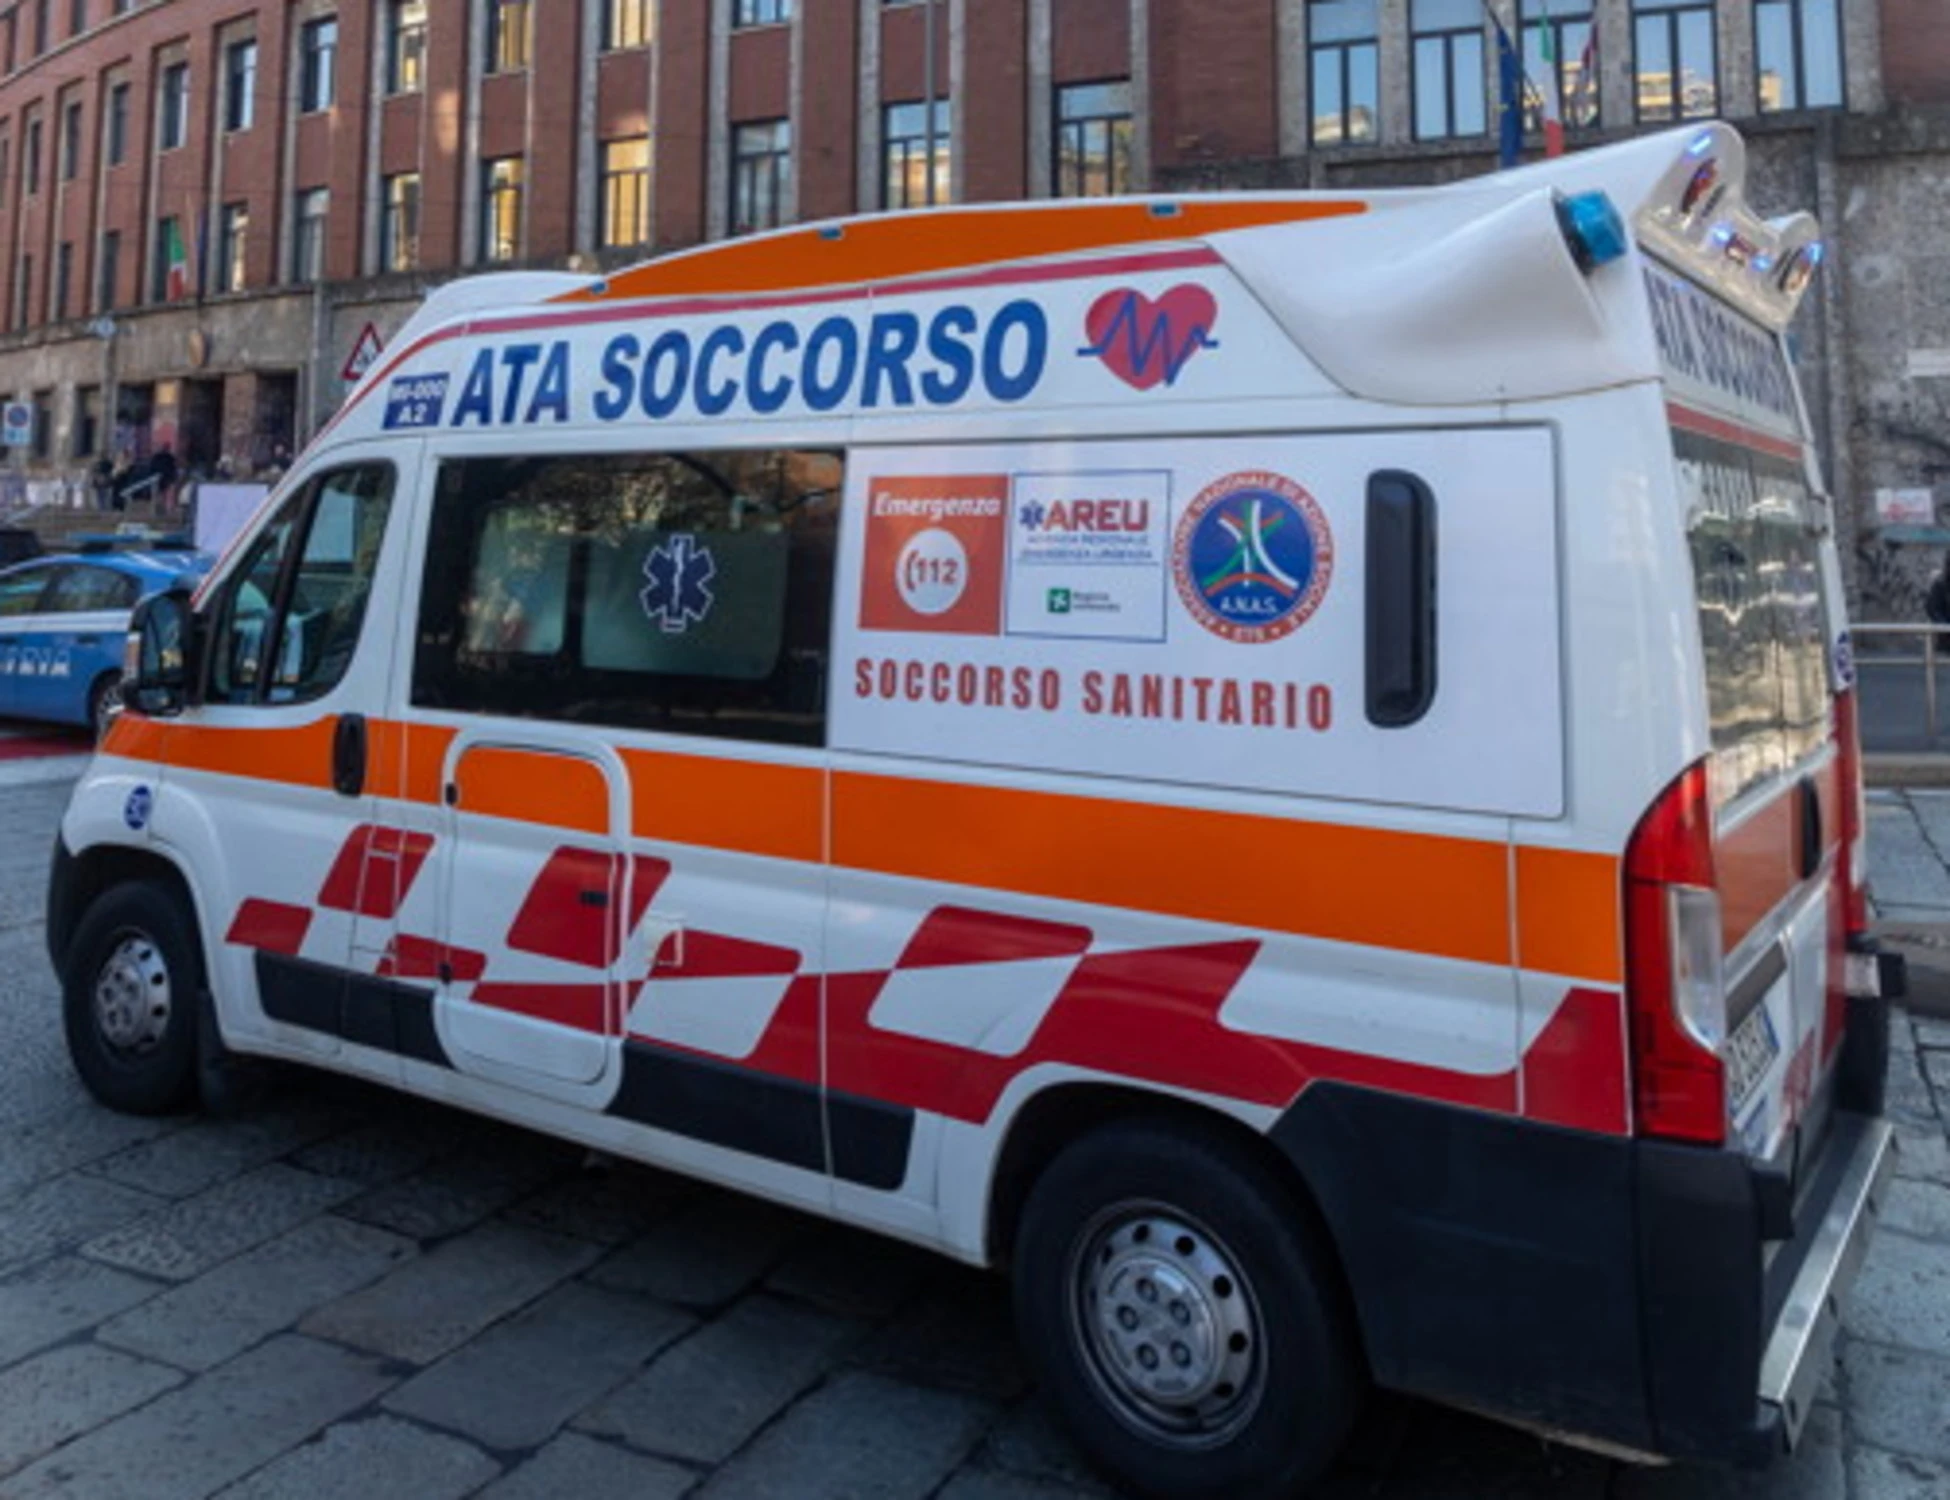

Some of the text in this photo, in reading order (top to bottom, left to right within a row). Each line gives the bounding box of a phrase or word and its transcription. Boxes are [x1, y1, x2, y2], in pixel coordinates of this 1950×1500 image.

[449, 299, 1048, 428] ATA SOCCORSO
[1043, 499, 1149, 531] AREU
[855, 657, 1333, 732] SOCCORSO SANITARIO
